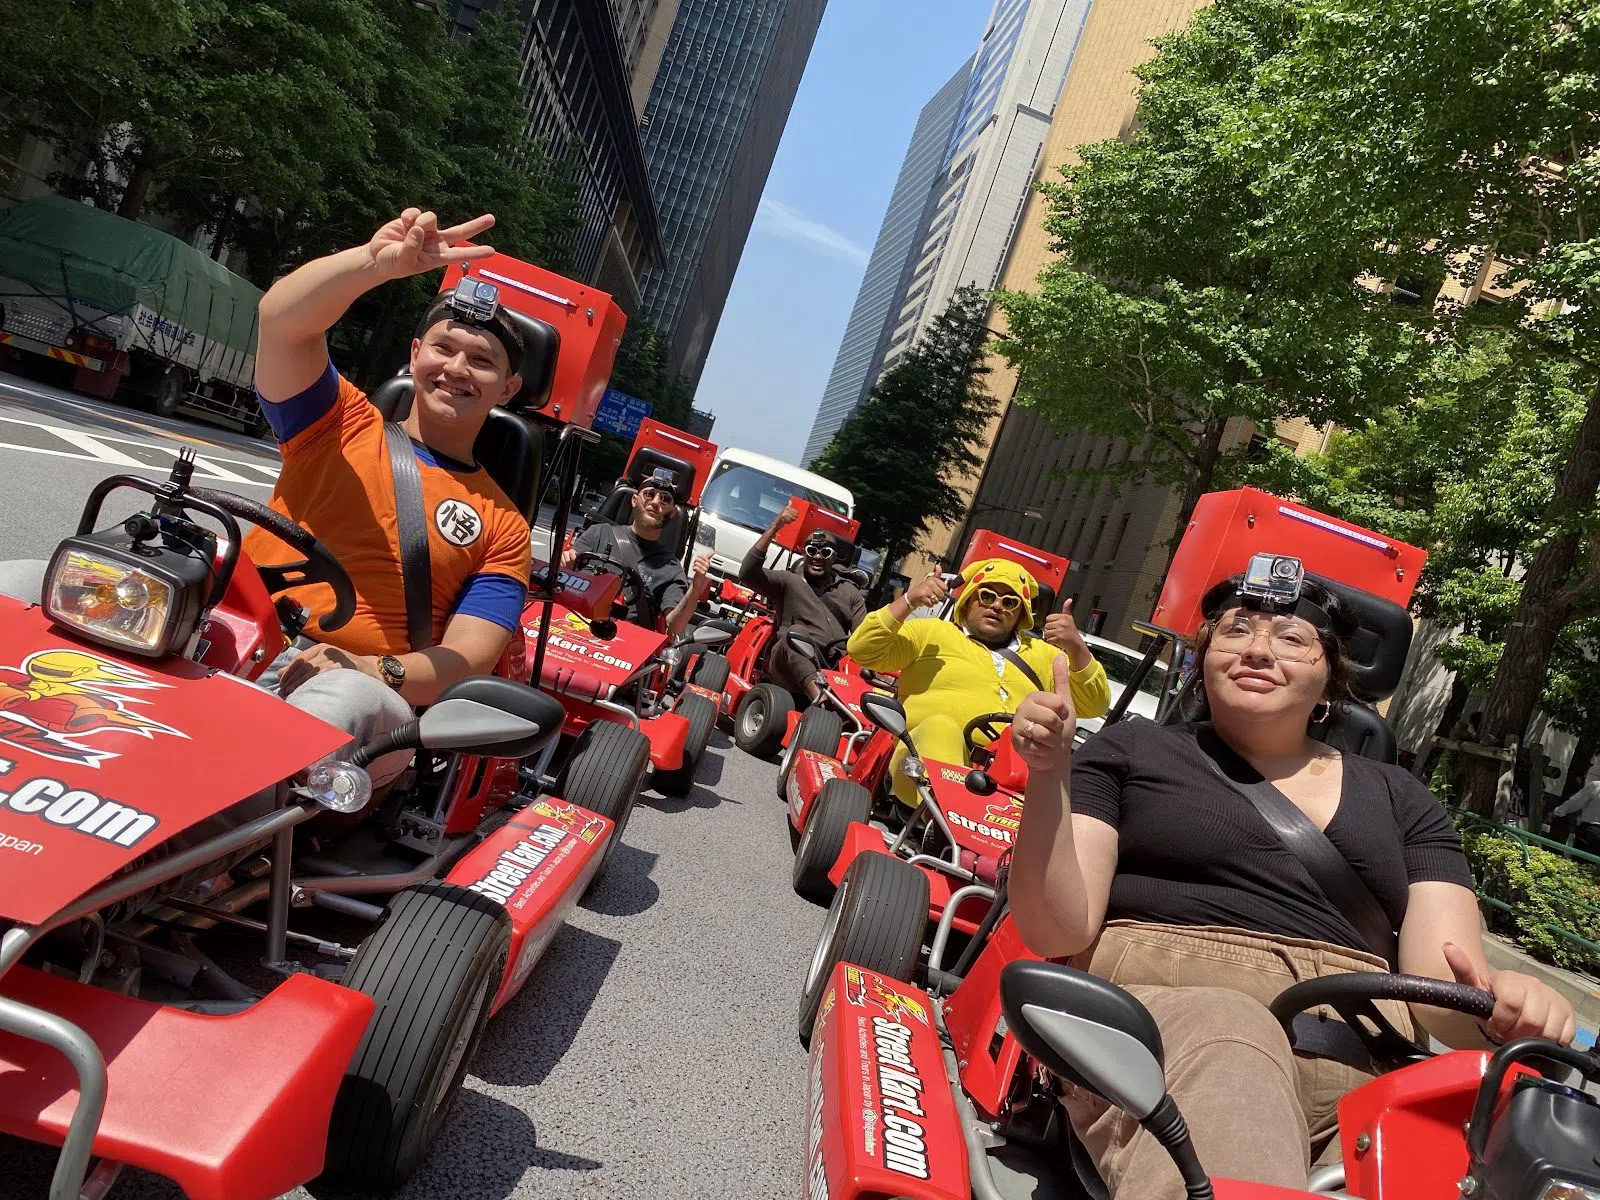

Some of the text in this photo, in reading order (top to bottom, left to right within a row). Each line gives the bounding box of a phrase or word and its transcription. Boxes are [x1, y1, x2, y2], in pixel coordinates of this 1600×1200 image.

[439, 502, 478, 544] 悟
[947, 810, 1013, 844] Street
[873, 1016, 917, 1073] Street
